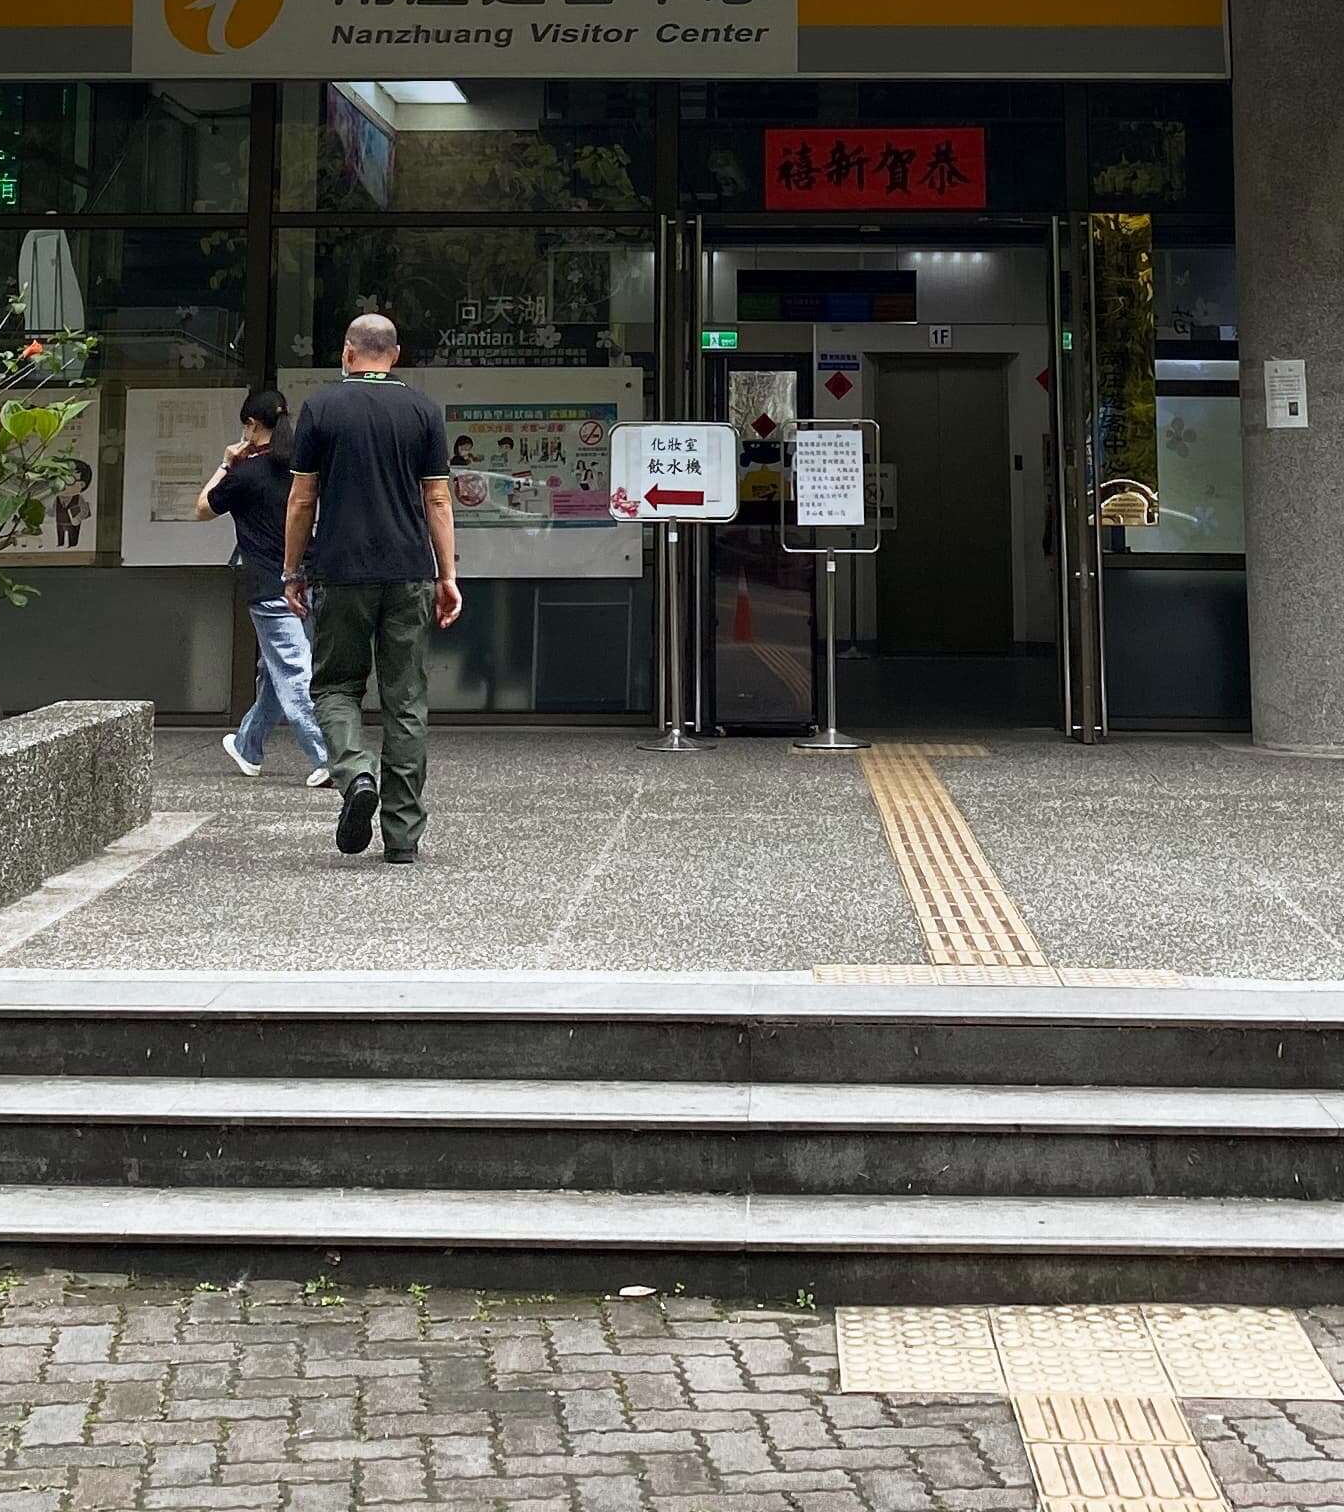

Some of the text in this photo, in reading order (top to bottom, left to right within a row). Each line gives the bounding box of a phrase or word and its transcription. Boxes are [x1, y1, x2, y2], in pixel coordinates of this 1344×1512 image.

[332, 23, 769, 48] Nanzhuang Visitor Center
[457, 296, 547, 325] 向天湖
[438, 329, 515, 347] Xiantian
[932, 329, 949, 345] 1F
[651, 437, 698, 452] 化妝室
[648, 458, 702, 476] 飲水機
